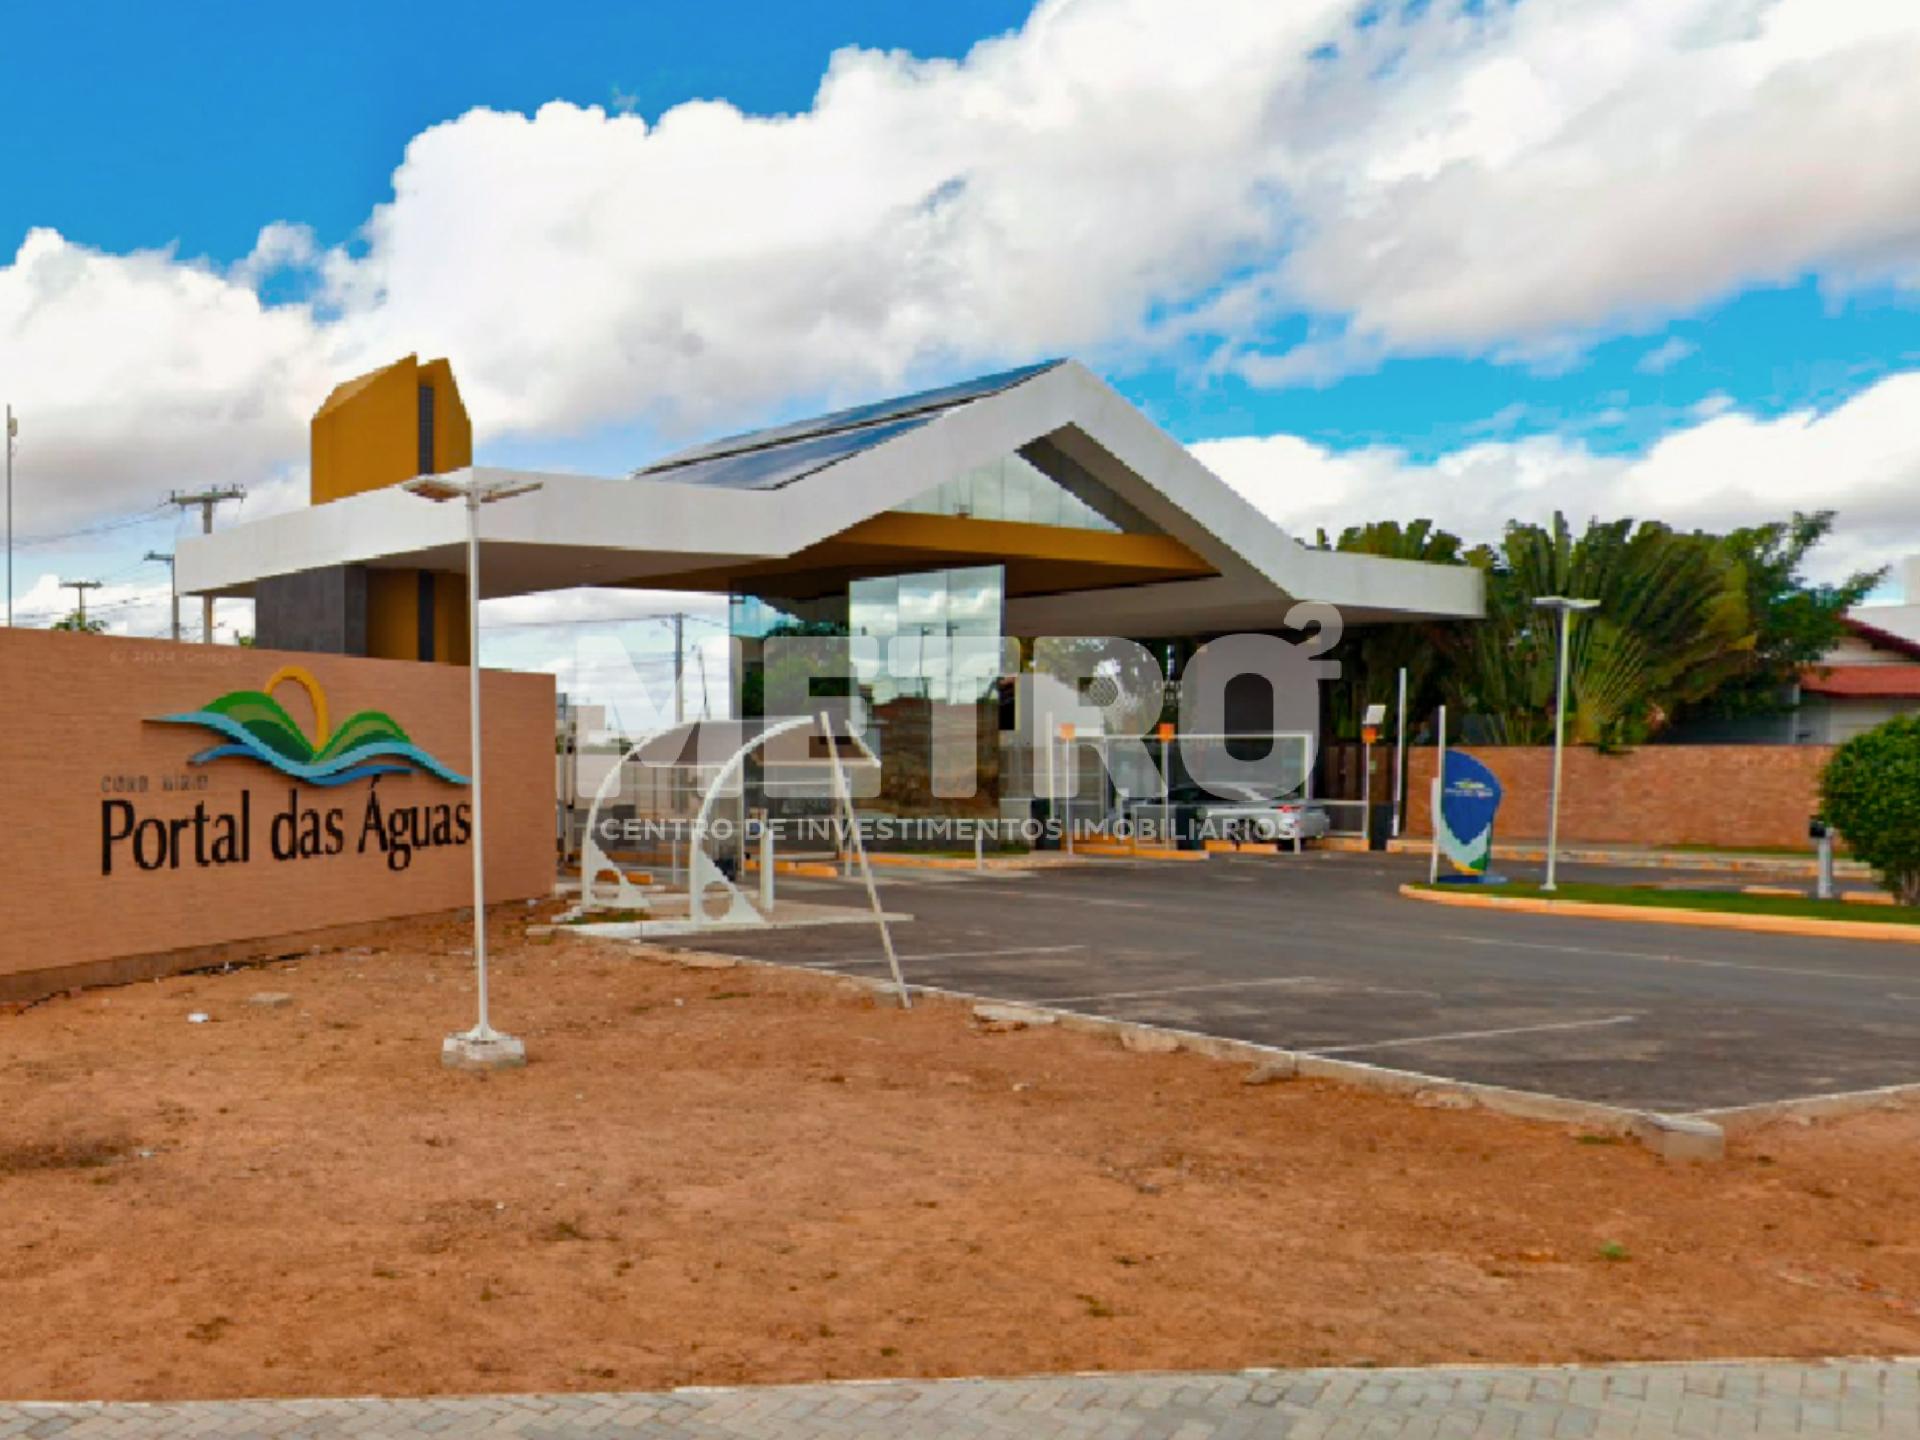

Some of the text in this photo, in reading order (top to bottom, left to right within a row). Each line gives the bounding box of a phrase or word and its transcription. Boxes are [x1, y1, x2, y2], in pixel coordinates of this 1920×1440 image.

[102, 774, 473, 876] Portal das Águas
